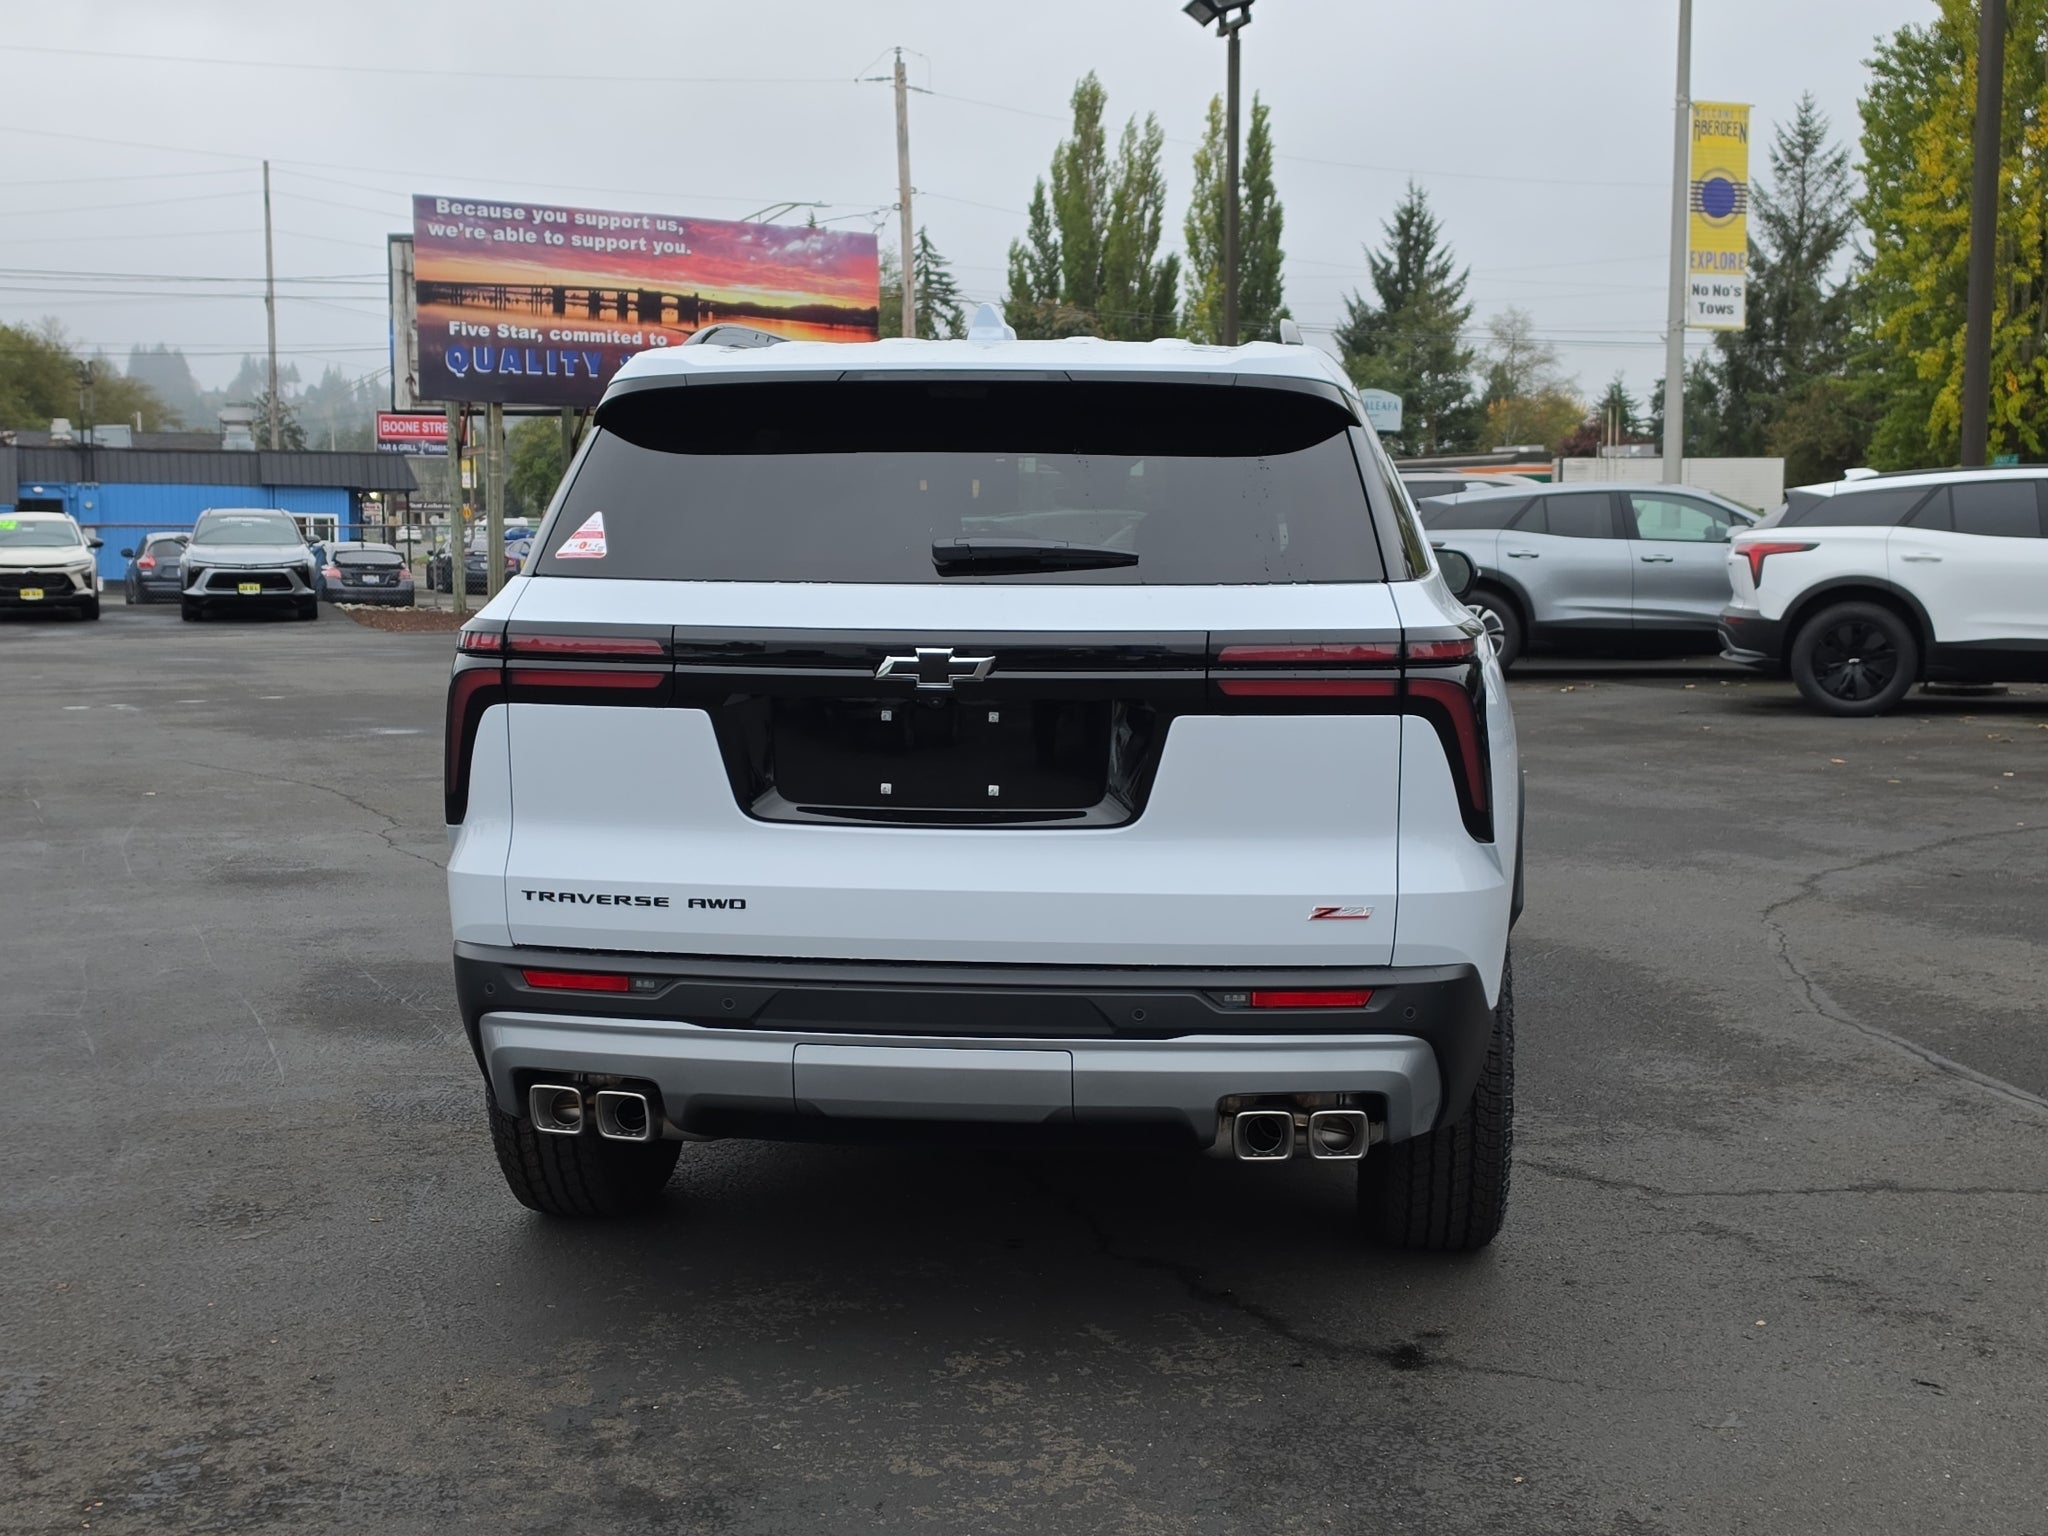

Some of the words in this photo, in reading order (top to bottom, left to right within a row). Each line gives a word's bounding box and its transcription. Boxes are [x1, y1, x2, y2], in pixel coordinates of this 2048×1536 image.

[1693, 119, 1747, 144] ABERDEEN
[435, 198, 526, 220] Because
[532, 208, 567, 225] you
[574, 212, 650, 230] support
[656, 219, 684, 236] us,
[427, 223, 487, 239] we're
[493, 226, 537, 243] able
[543, 229, 565, 245] to
[571, 234, 647, 252] support
[653, 240, 692, 256] you.
[1689, 249, 1745, 270] EXPLORE
[1692, 283, 1709, 297] No
[1713, 283, 1742, 297] No's
[1698, 301, 1735, 315] Tows
[449, 321, 490, 337] Five
[497, 323, 543, 342] Star,
[549, 327, 642, 346] commited
[649, 332, 668, 346] to
[445, 344, 603, 378] QUALITY
[382, 420, 420, 433] BOONE
[422, 420, 449, 434] STRE
[521, 889, 670, 908] TRAVERSE
[688, 898, 747, 910] AWD
